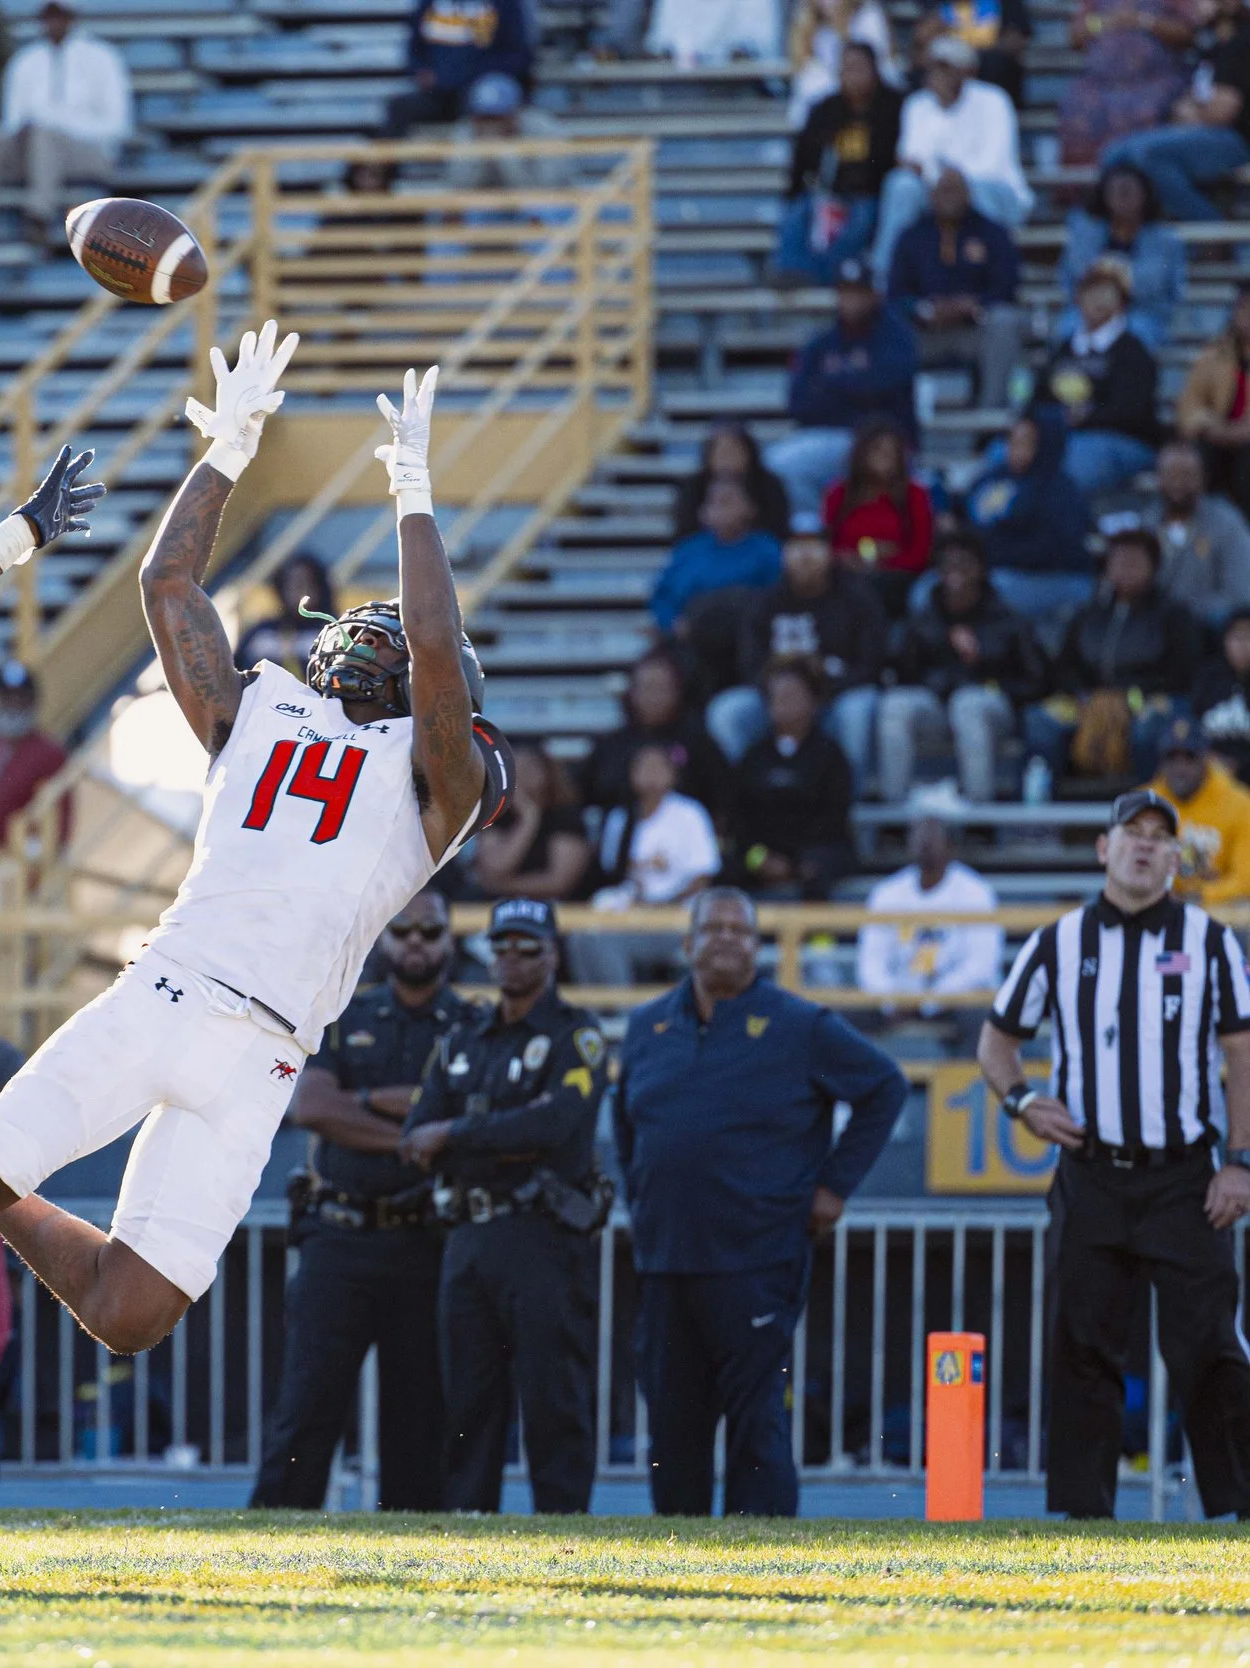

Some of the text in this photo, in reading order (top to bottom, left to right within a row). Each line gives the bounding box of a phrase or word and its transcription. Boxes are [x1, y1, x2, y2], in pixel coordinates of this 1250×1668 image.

[276, 703, 306, 716] CAA
[297, 726, 356, 742] CAMLL
[241, 740, 369, 845] 14
